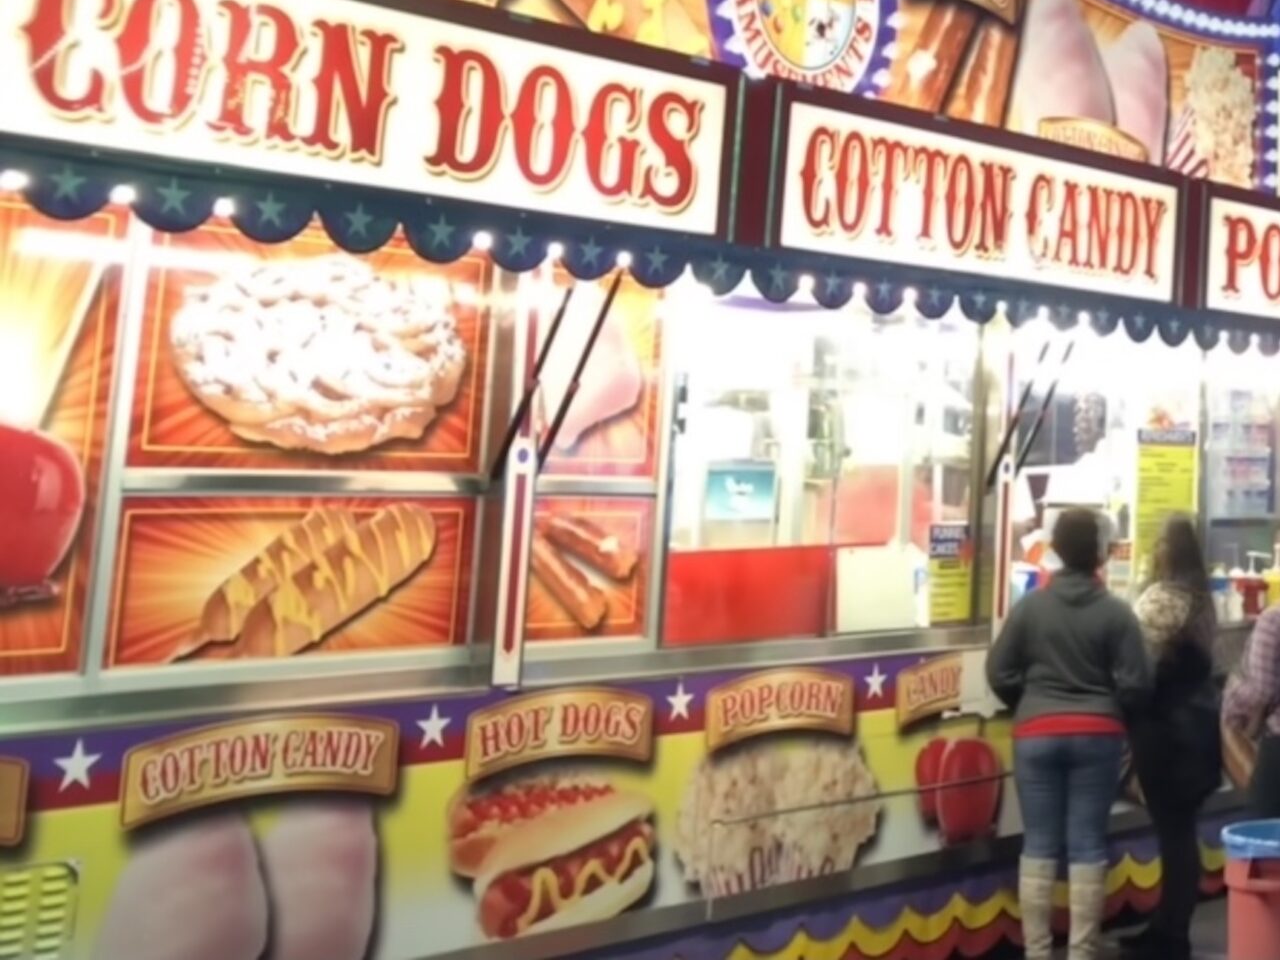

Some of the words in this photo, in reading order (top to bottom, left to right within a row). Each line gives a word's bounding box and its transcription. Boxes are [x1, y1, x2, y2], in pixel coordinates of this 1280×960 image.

[423, 44, 704, 214] DOGS
[799, 125, 1017, 261] COTTON
[1025, 173, 1168, 284] CANDY
[720, 681, 843, 729] POPCORN
[905, 664, 961, 708] CANDY
[478, 706, 549, 759] HOT
[560, 700, 645, 743] DOGS
[140, 731, 277, 801] COTTON
[282, 728, 382, 773] CANDY
